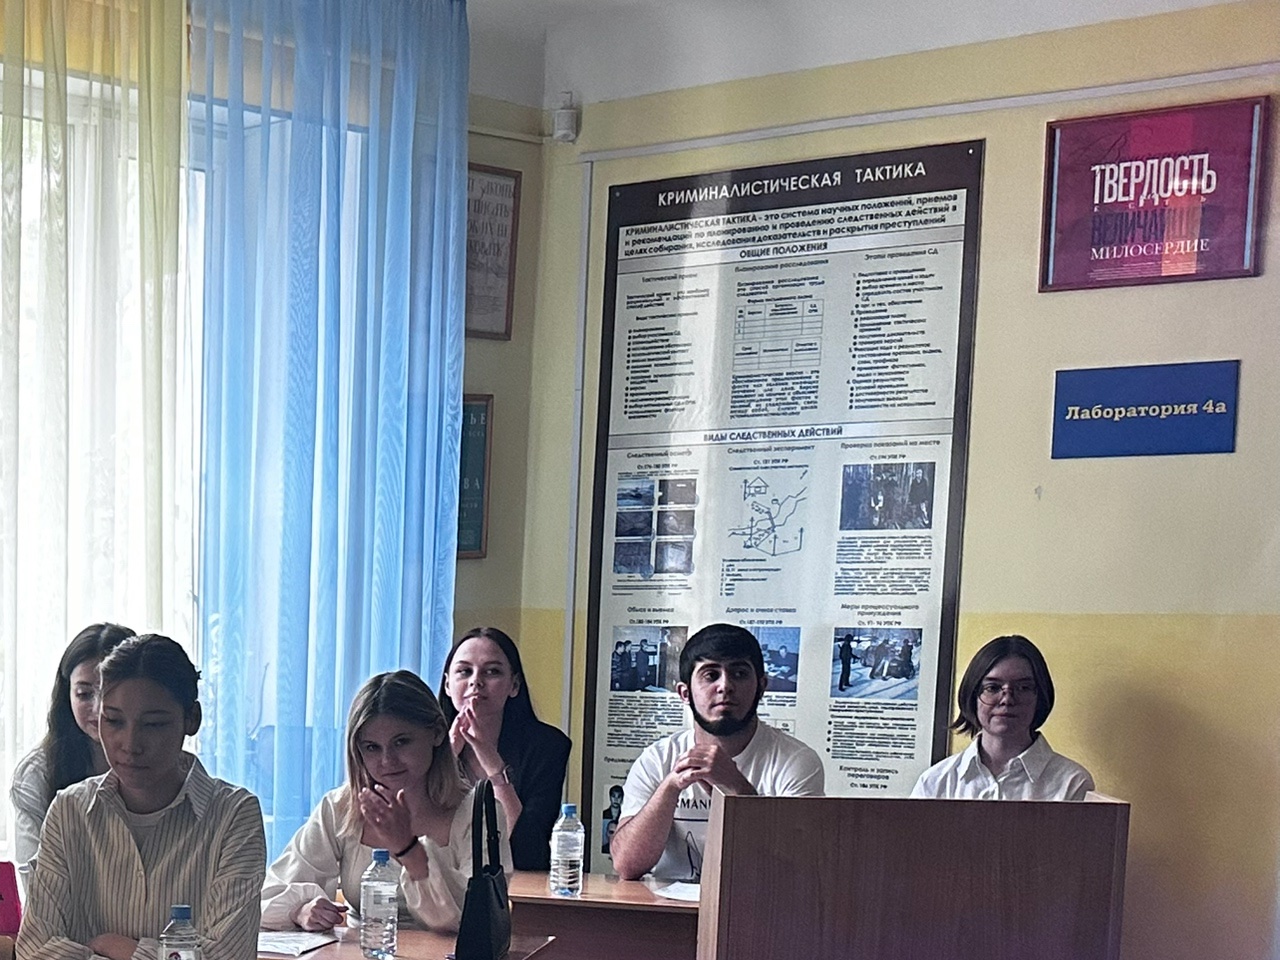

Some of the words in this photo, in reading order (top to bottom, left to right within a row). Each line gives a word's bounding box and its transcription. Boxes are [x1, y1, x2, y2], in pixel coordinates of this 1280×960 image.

[658, 170, 842, 207] КРИМИНАЛИСТИЧЕСКАЯ
[855, 161, 927, 184] ТАКТИКА
[1091, 153, 1217, 207] ТВЕРДОСТЬ
[722, 214, 757, 226] ТАКТИКА
[781, 209, 820, 220] система
[772, 242, 828, 256] ПОЛОЖЕНИЯ
[1091, 239, 1210, 260] МИЛОСЕРДИЕ
[1065, 401, 1198, 421] Лаборатория
[1202, 399, 1227, 414] 4а
